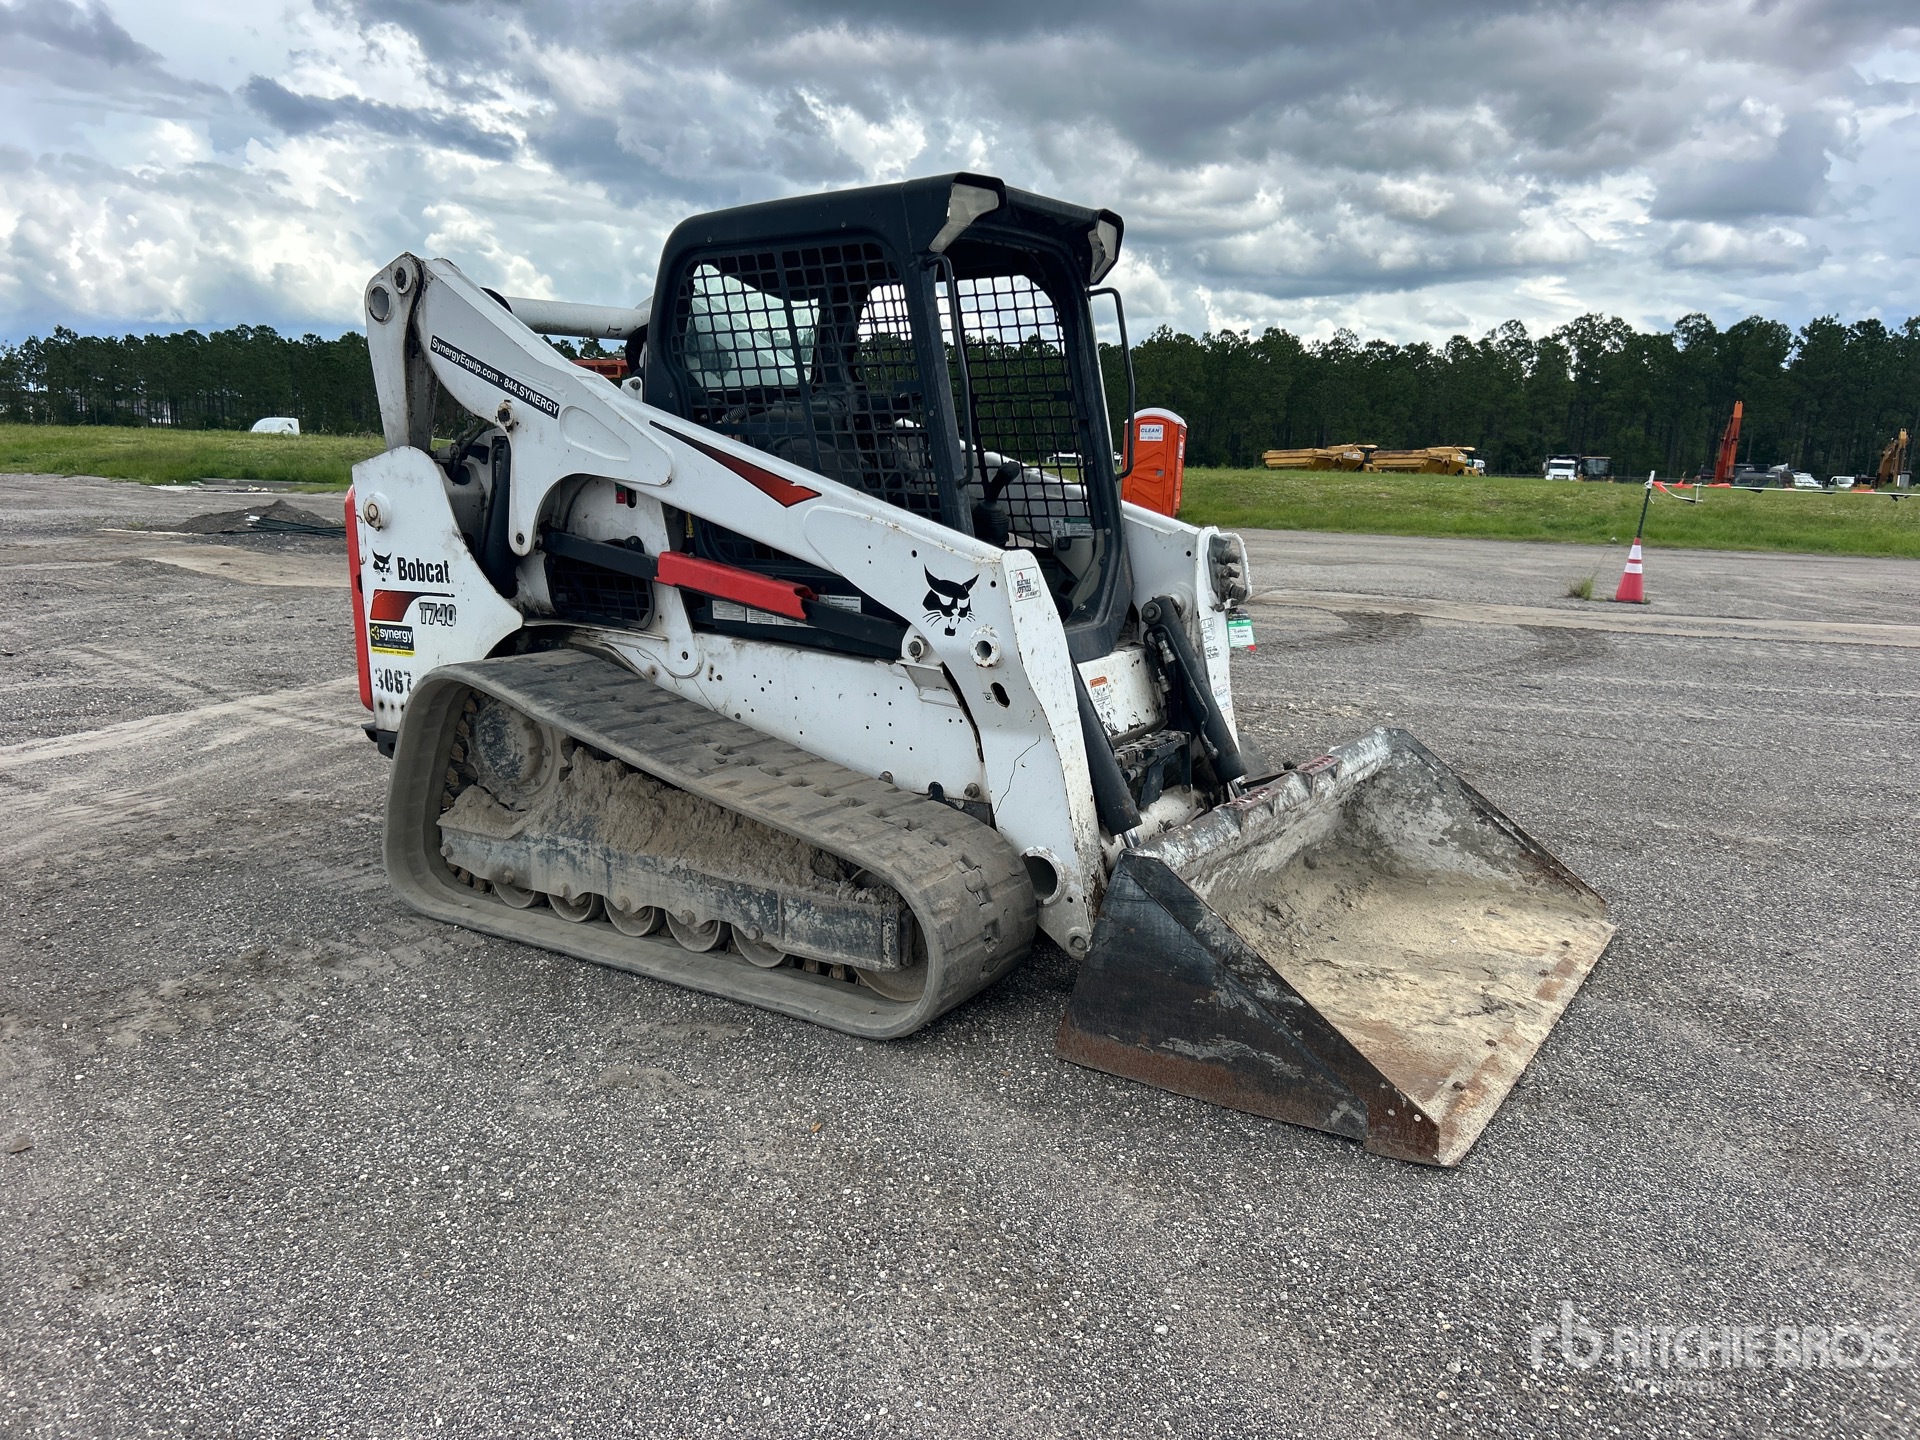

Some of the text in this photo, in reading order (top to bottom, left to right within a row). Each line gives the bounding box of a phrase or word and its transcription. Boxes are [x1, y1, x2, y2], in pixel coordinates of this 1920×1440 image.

[431, 338, 560, 415] SynergyEquip.com 844.SYNERGY
[397, 557, 450, 583] Bobcat
[418, 602, 457, 626] T740
[380, 628, 412, 643] synergy
